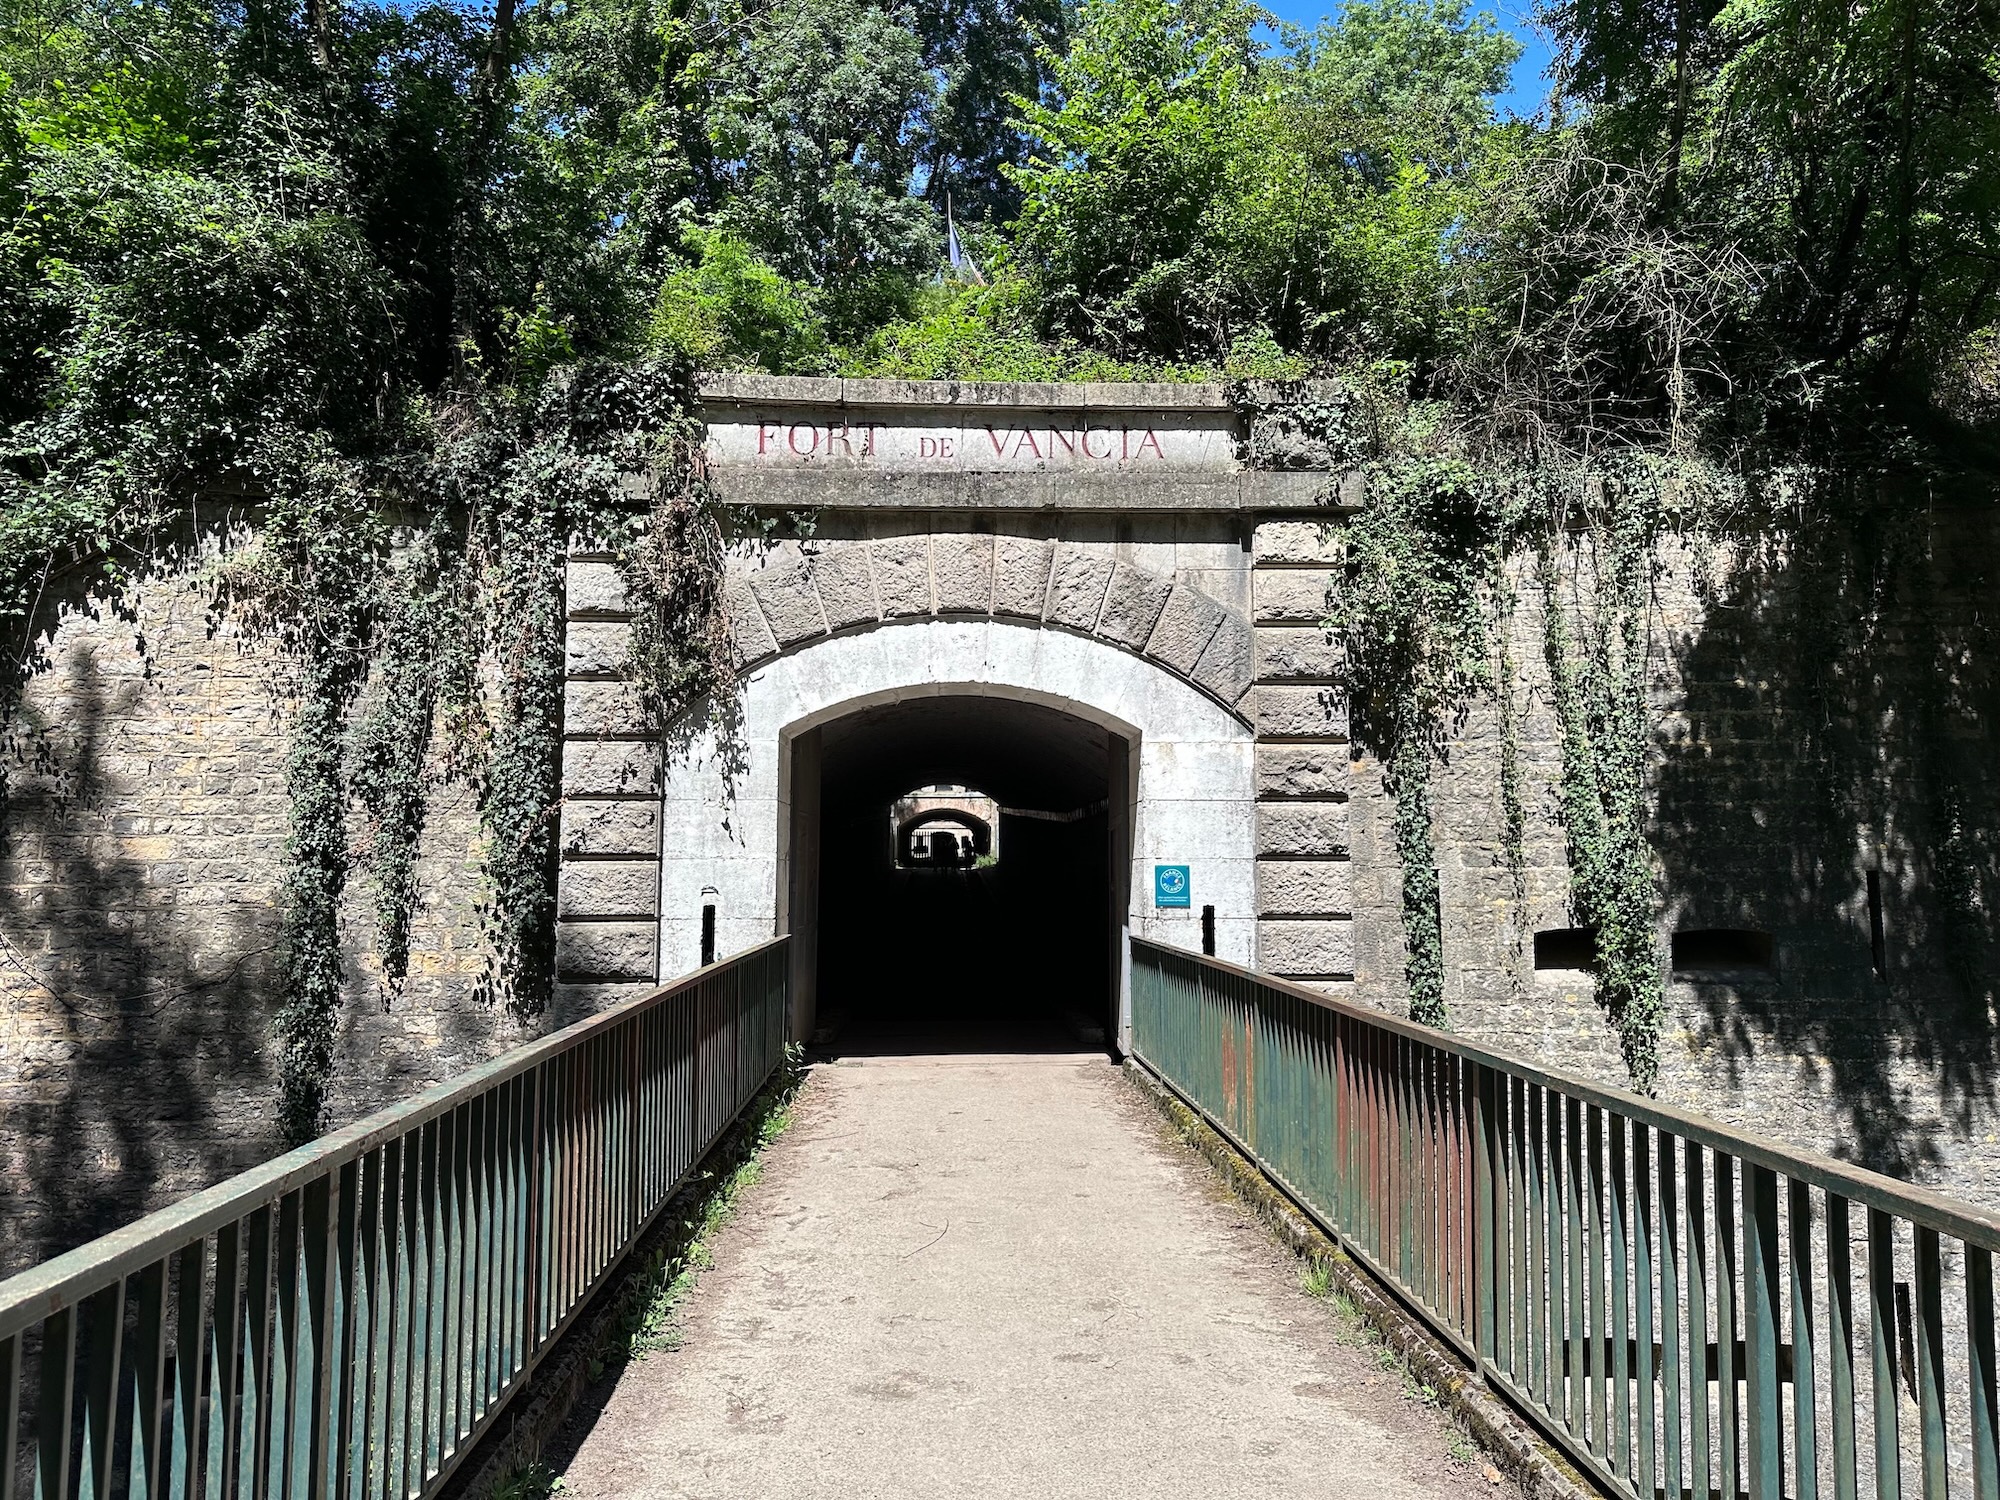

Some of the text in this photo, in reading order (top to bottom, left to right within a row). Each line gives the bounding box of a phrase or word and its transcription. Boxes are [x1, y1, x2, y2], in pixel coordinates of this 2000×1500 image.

[757, 420, 1165, 459] FORT DE VANCIA
